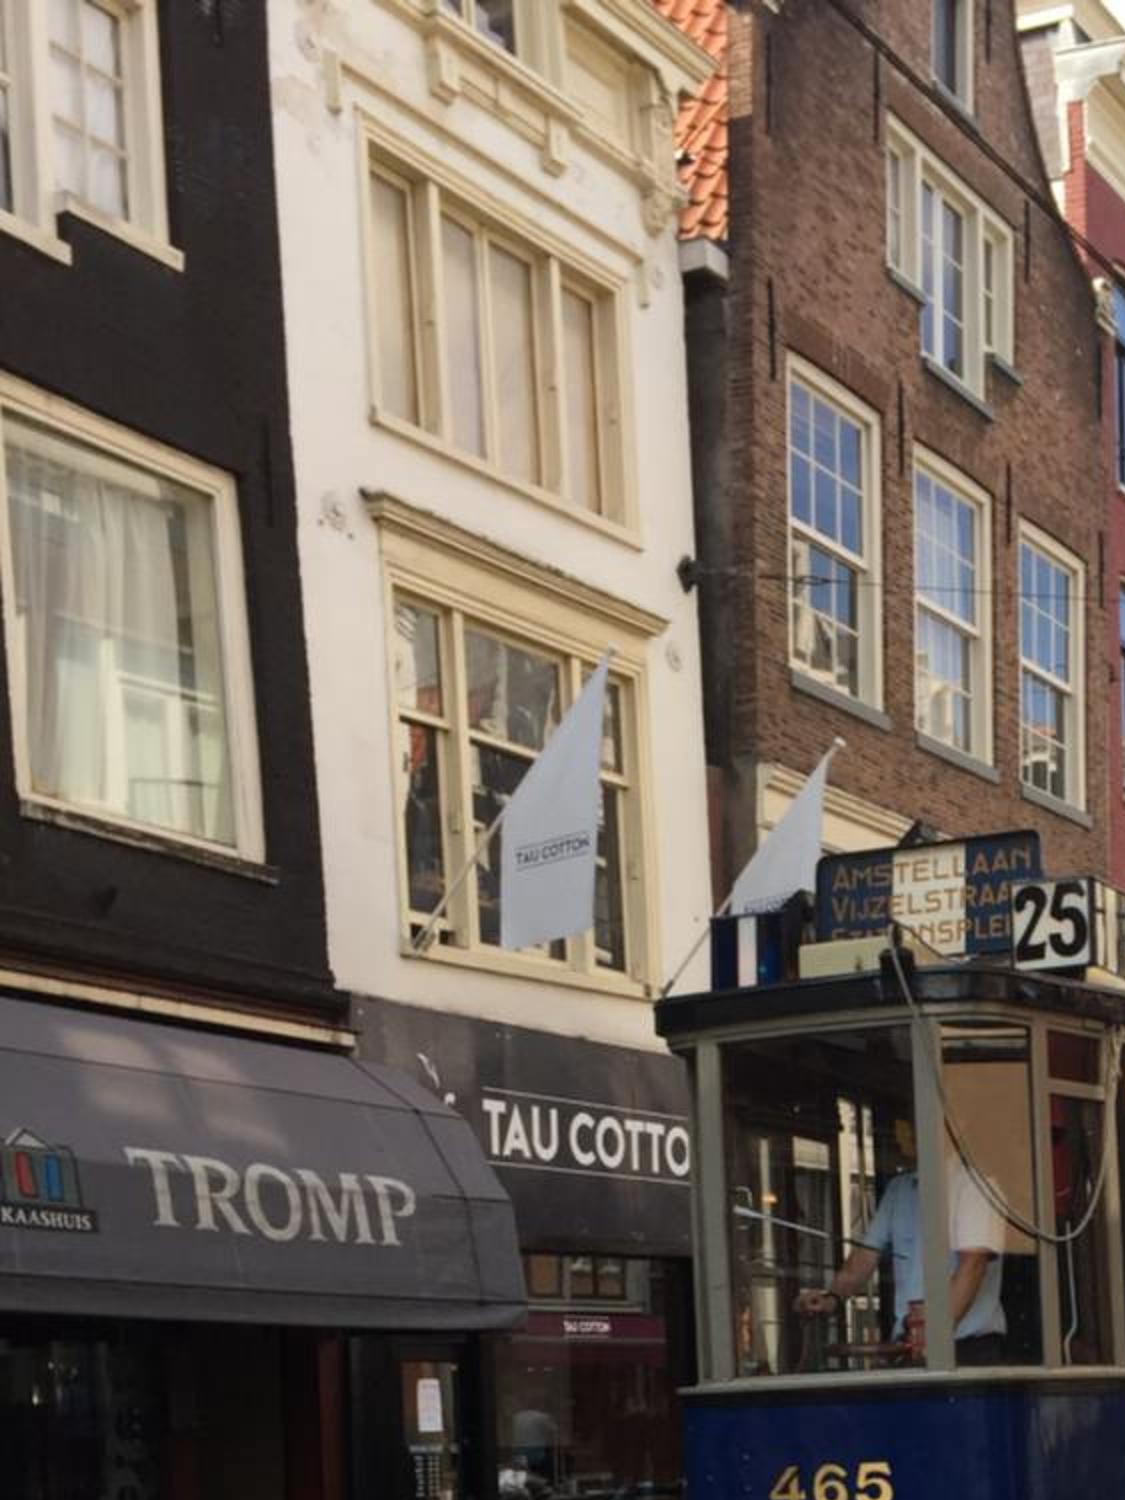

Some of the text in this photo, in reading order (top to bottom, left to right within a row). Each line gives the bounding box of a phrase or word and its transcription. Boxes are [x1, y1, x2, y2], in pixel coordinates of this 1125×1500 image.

[515, 838, 590, 865] TAU COTTON
[832, 846, 1031, 891] AMSTELLAAN
[1013, 881, 1088, 960] 25
[482, 1098, 690, 1176] TAU COTTO
[1, 1206, 93, 1231] KAASHUIS
[123, 1146, 416, 1247] TROMP
